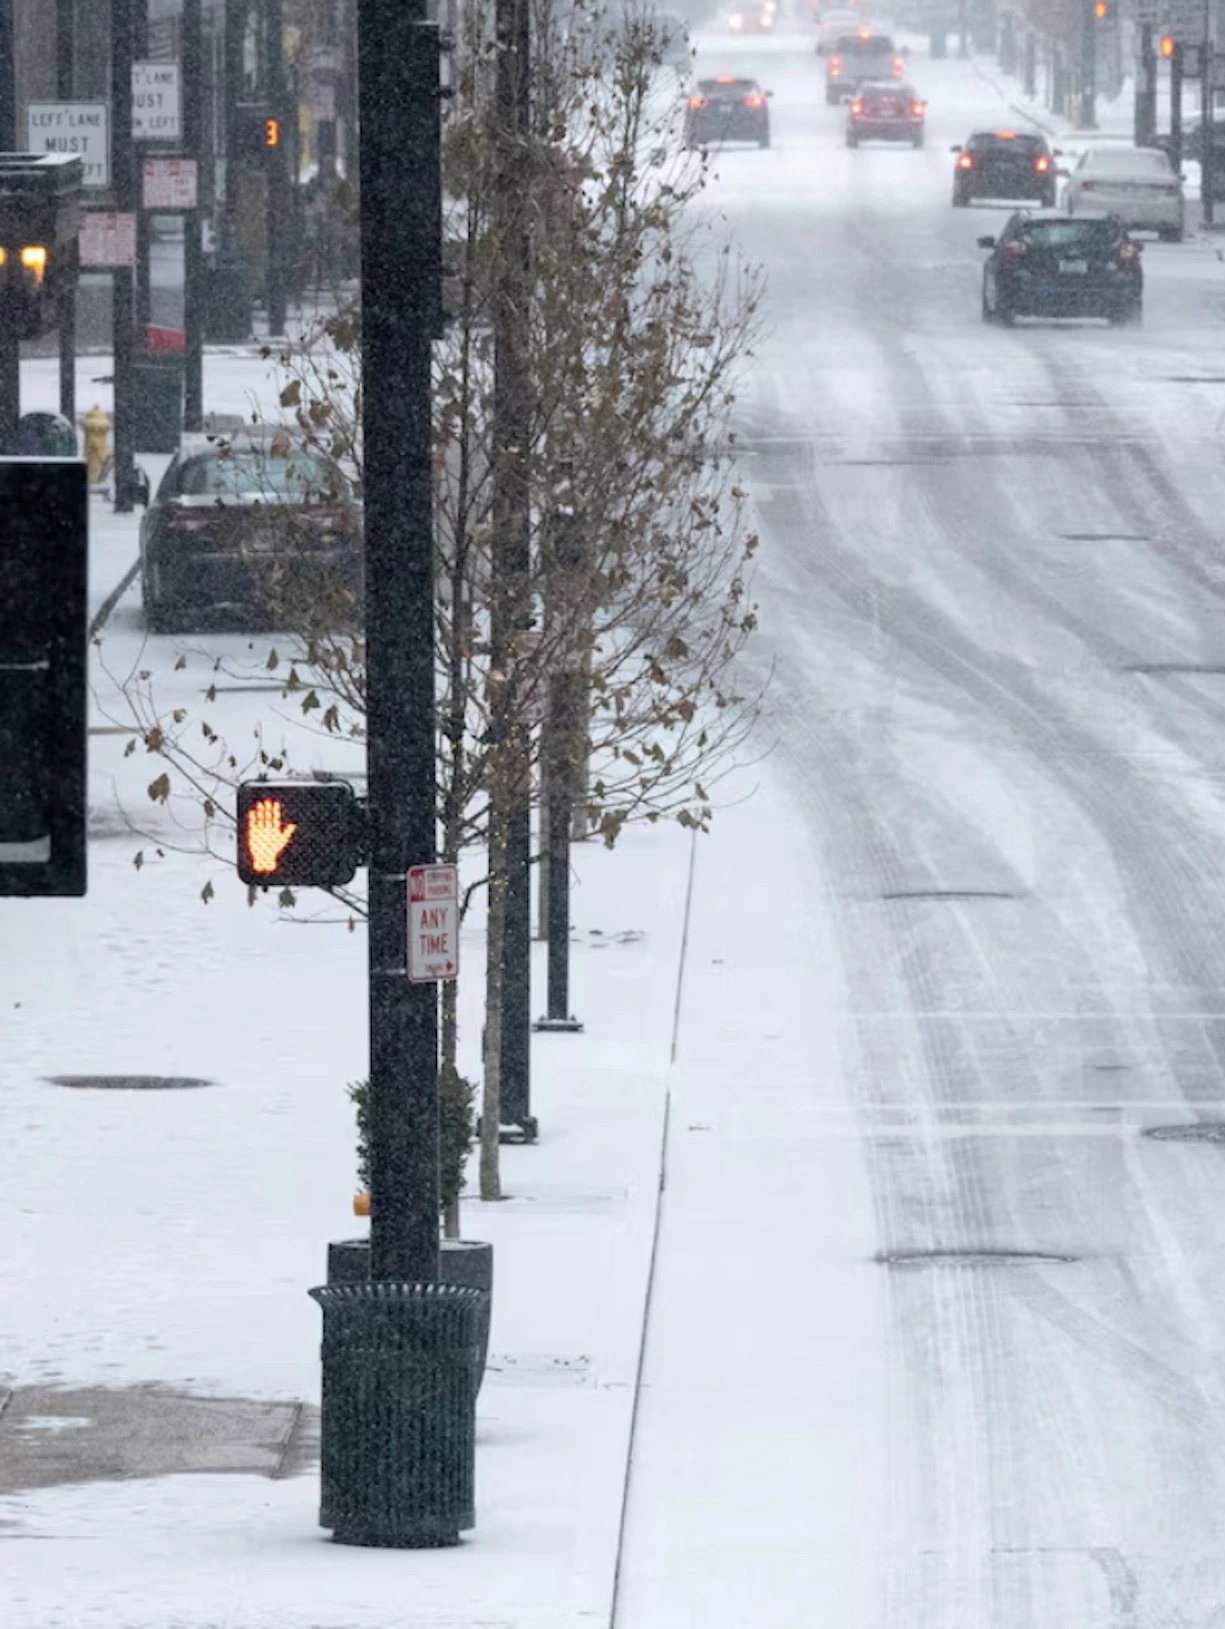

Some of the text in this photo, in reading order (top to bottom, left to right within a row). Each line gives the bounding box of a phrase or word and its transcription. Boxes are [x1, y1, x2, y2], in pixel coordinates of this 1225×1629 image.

[136, 93, 163, 108] UST
[31, 113, 101, 127] LEFT LANE
[148, 116, 175, 129] LEFT
[265, 118, 279, 146] 3
[45, 137, 88, 152] MUST
[84, 163, 103, 178] FT
[421, 907, 448, 930] ANY
[419, 933, 449, 956] TIME
